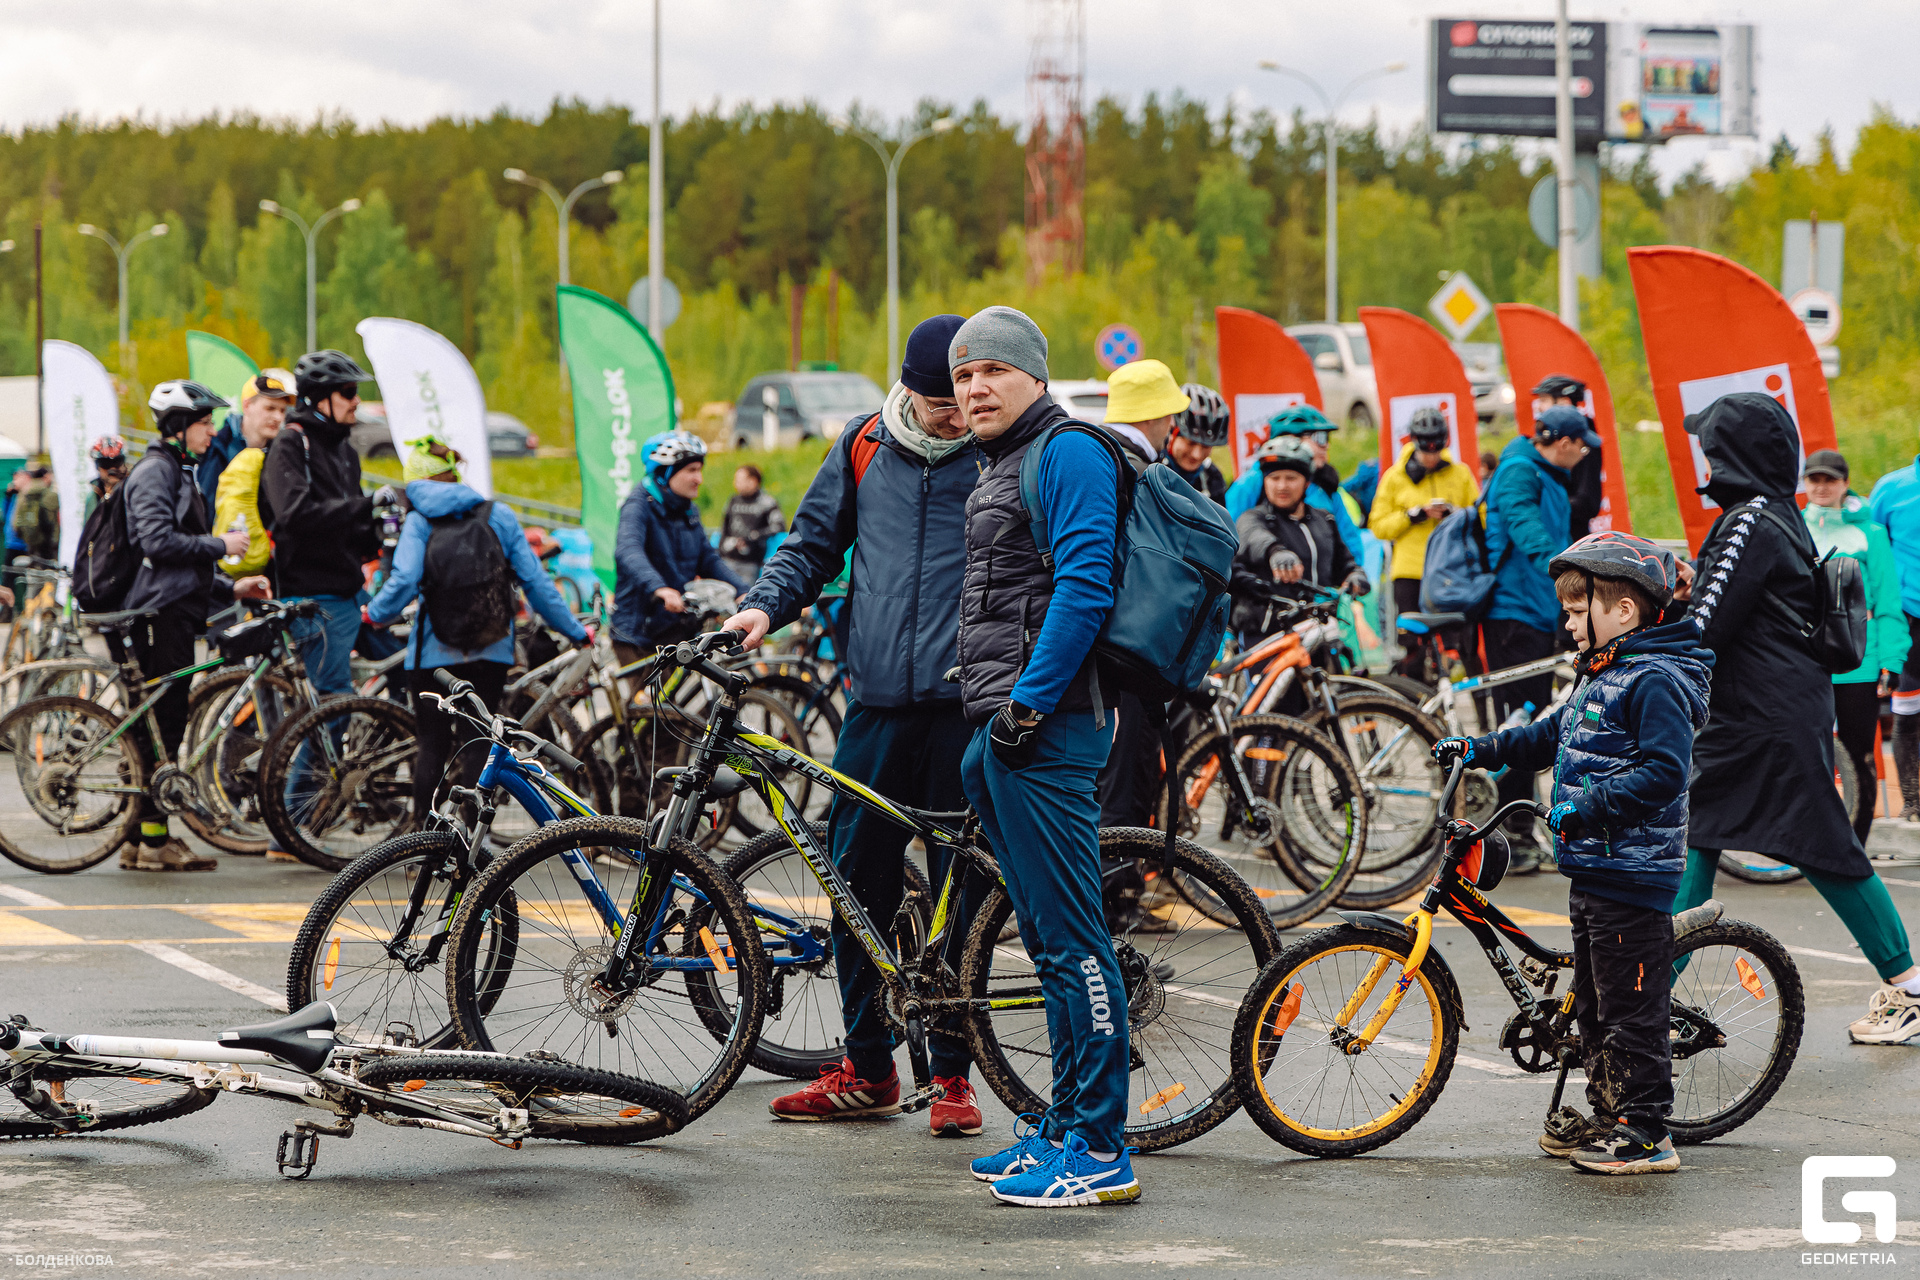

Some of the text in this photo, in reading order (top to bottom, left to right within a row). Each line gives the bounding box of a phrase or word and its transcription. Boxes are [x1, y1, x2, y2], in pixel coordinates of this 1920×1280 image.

[1587, 702, 1603, 714] MAKE
[1585, 710, 1600, 722] YOUR
[1485, 946, 1544, 1021] STERN
